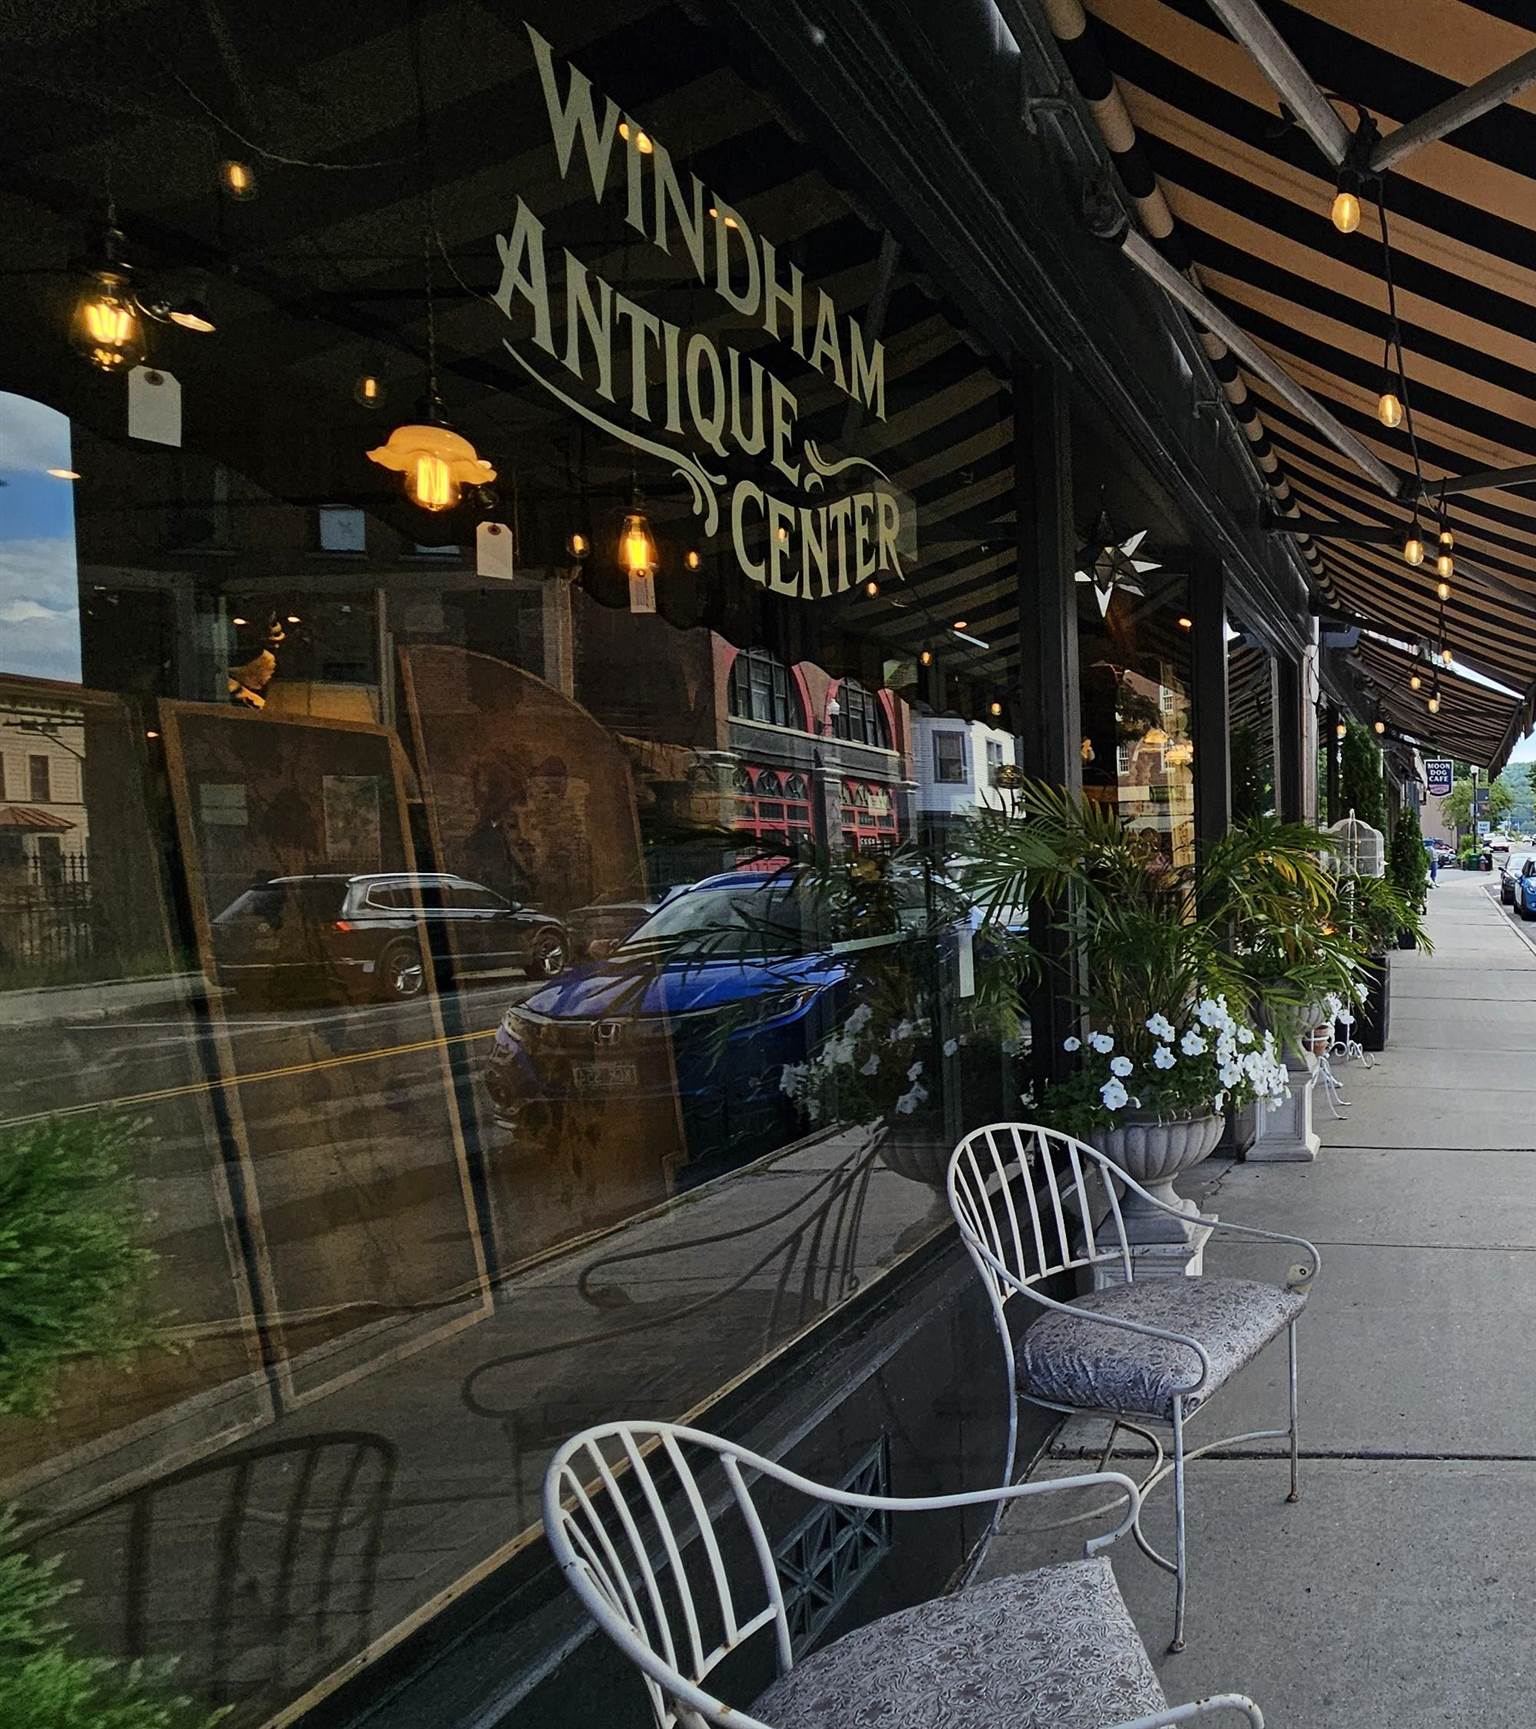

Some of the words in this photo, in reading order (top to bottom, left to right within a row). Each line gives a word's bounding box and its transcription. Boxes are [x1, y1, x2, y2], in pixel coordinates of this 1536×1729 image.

[523, 19, 887, 423] WINDHAM
[490, 194, 801, 488] ANTIQUE
[731, 479, 905, 600] CENTER
[1427, 762, 1451, 770] MOON
